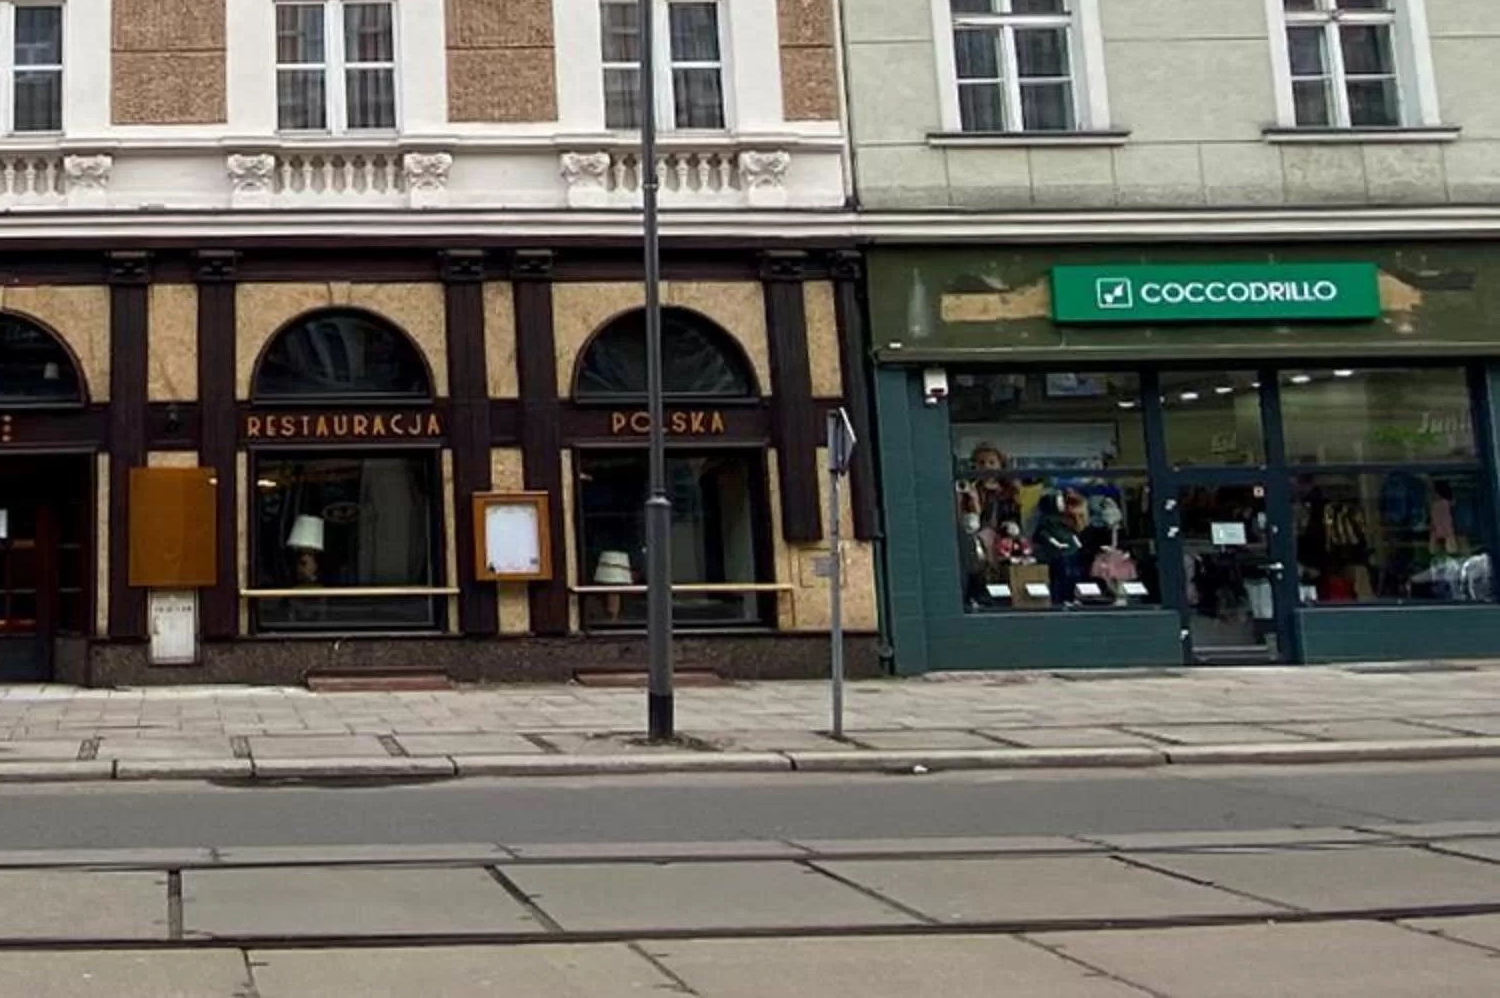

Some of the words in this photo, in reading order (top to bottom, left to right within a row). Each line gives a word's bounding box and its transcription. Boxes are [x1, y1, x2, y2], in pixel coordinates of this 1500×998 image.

[1141, 280, 1337, 303] COCCODRILLO
[247, 414, 441, 437] RESTAURACJA
[611, 411, 725, 434] POSKA
